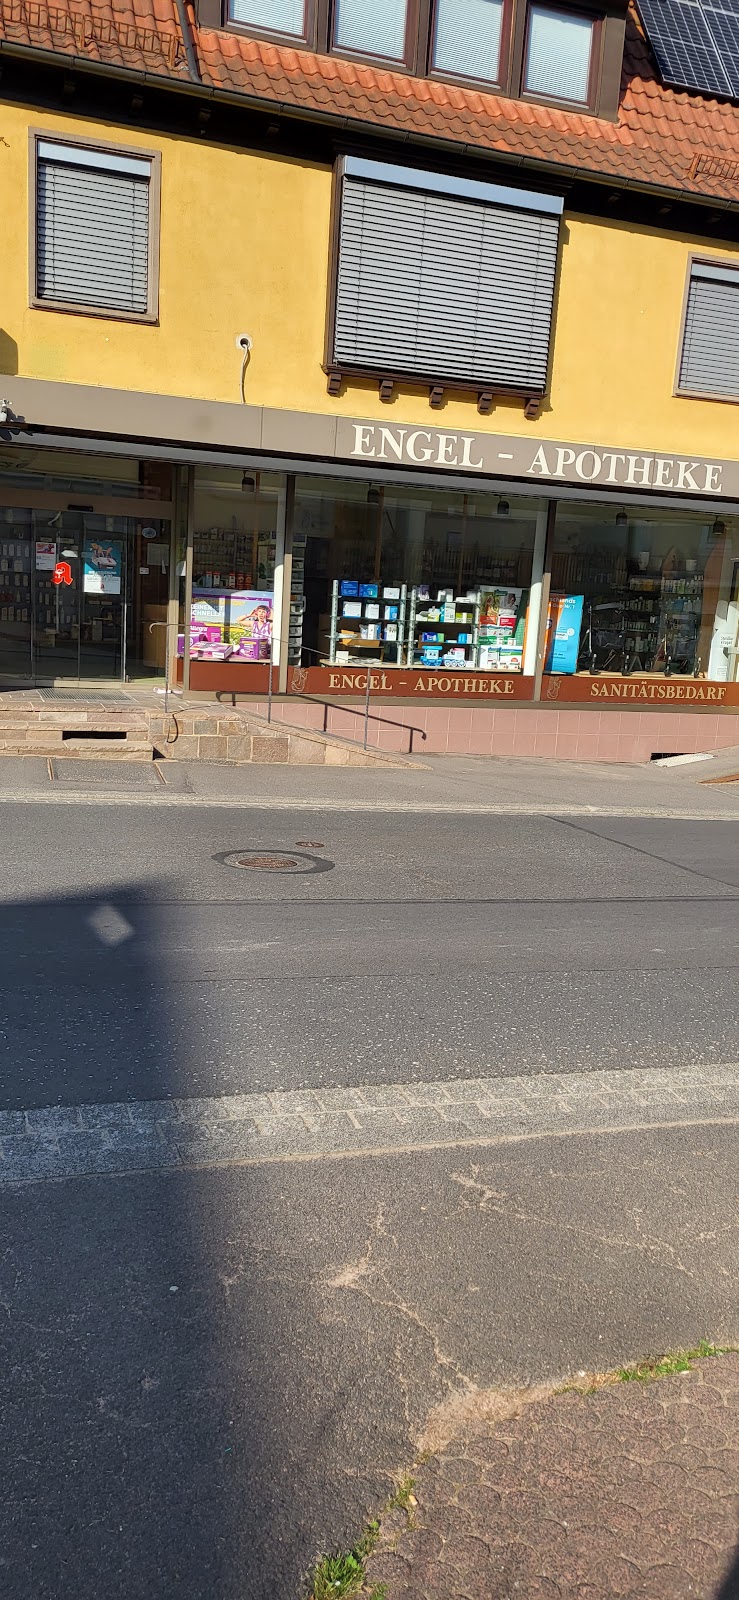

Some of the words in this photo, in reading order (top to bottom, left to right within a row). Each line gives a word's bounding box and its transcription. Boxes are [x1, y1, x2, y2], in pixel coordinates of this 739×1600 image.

[350, 424, 483, 468] ENGEL
[526, 444, 723, 493] APOTHEKE
[328, 673, 393, 690] ENGEL
[413, 676, 515, 694] APOTHEKE
[590, 681, 727, 700] SANITÄTSBEDARF
